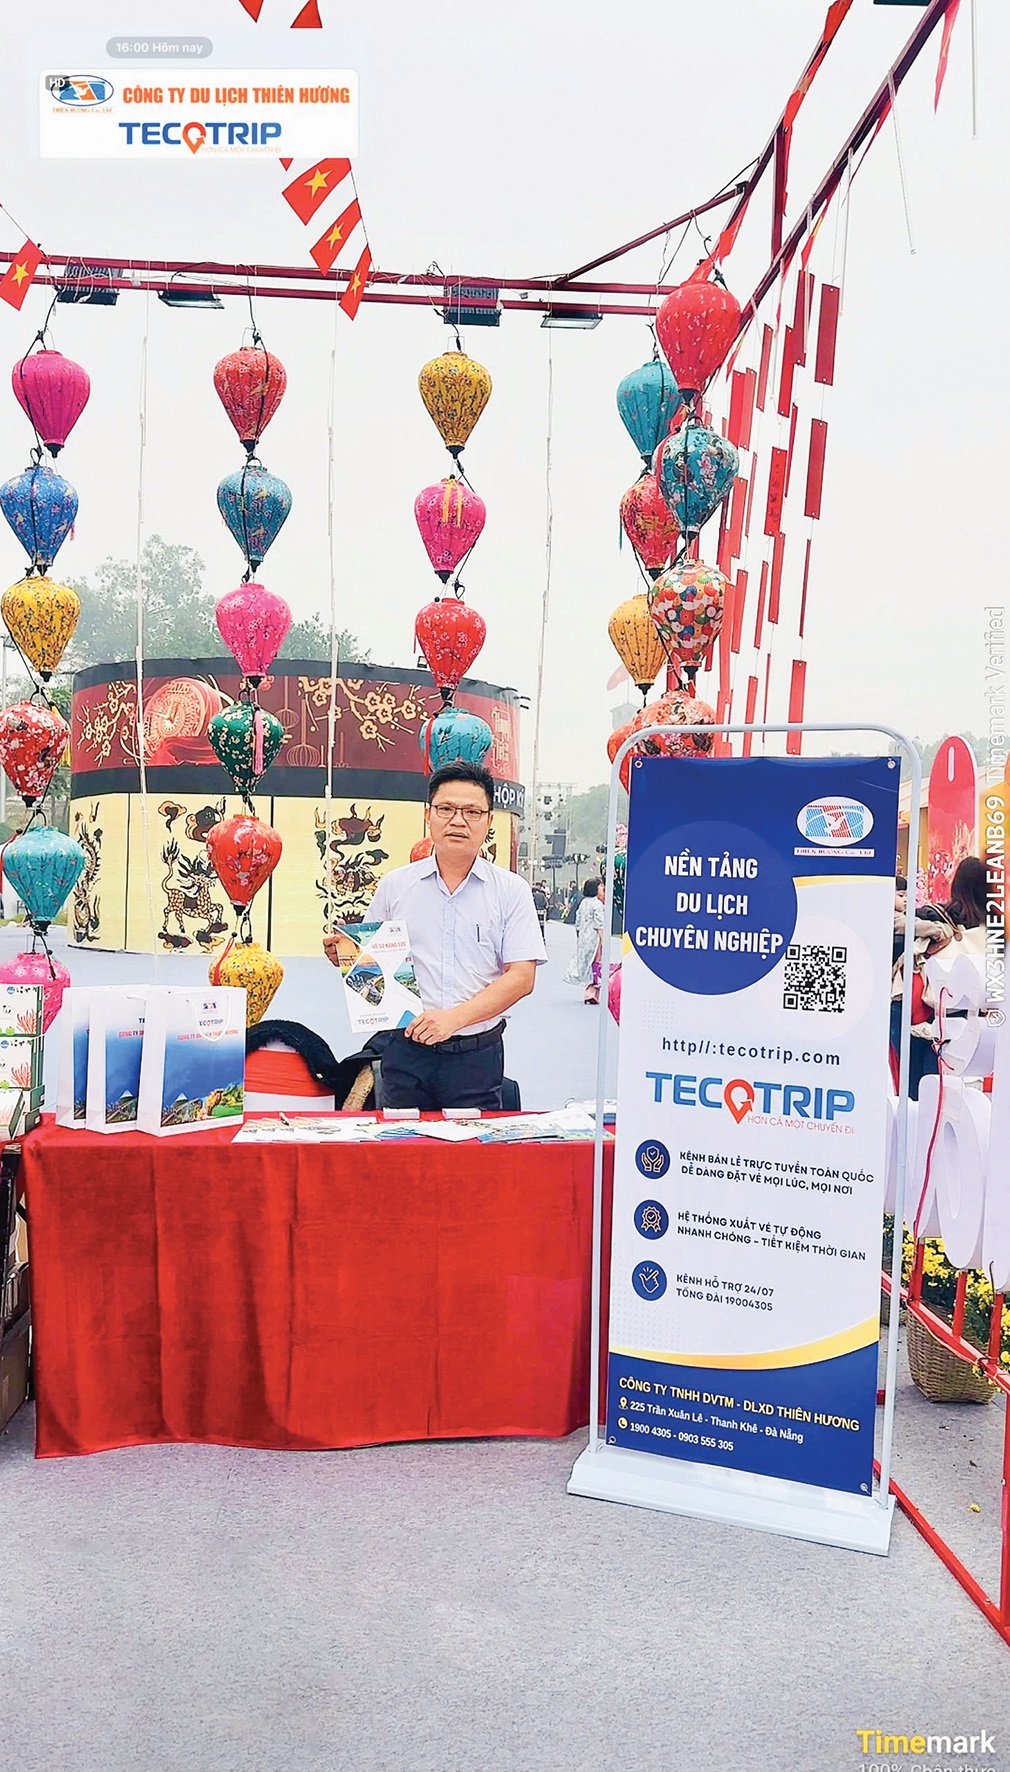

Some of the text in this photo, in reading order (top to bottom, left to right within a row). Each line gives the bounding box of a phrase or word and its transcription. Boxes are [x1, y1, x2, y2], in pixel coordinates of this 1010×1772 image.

[664, 848, 758, 879] NỀN TẢNG
[676, 892, 748, 920] DU LỊCH
[635, 924, 783, 960] CHUYÊN NGHIỆP
[662, 1036, 841, 1066] http//:tecotrip.com
[645, 1071, 855, 1124] TECOTRIP
[747, 1114, 854, 1135] HƠN CẢ MỘT CHUYẾN ĐI
[680, 1151, 875, 1183] KÊNH BÁN LẺ TRỰC TUYẾN TOÀN QUỐC
[681, 1161, 853, 1195] DỄ DÀNG ĐẶT VÉ MỌI LÚC, MỌI NƠI
[678, 1211, 822, 1240] HỆ THỐNG XUẤT VÉ TỰ ĐỘNG
[677, 1225, 712, 1239] NHANH
[714, 1229, 751, 1245] CHÓNG
[761, 1236, 783, 1249] TIẾT
[785, 1239, 810, 1254] KIỆM
[812, 1244, 838, 1257] THỜI
[839, 1248, 866, 1261] GIAN
[676, 1273, 774, 1297] KÊNH HỖ TRỢ 24/07
[676, 1286, 773, 1311] TỔNG ĐÀI 19004305
[619, 1376, 651, 1393] CÔNG
[653, 1383, 668, 1396] TY
[670, 1386, 700, 1402] TNHH
[702, 1393, 734, 1408] DVTM
[743, 1400, 774, 1416] DLXD
[777, 1405, 811, 1423] THIÊN
[814, 1412, 860, 1431] HƯƠNG
[630, 1401, 646, 1412] 225
[647, 1404, 666, 1417] Trần
[668, 1408, 690, 1421] Xuân
[692, 1412, 703, 1423] Lê
[710, 1415, 738, 1430] Thanh
[740, 1421, 758, 1433] Khê
[765, 1426, 778, 1438] Đà
[780, 1428, 804, 1444] Nẵng
[630, 1422, 650, 1434] 1900
[651, 1426, 672, 1439] 4305
[678, 1432, 699, 1444] 0903
[700, 1436, 717, 1448] 555
[718, 1439, 734, 1451] 305
